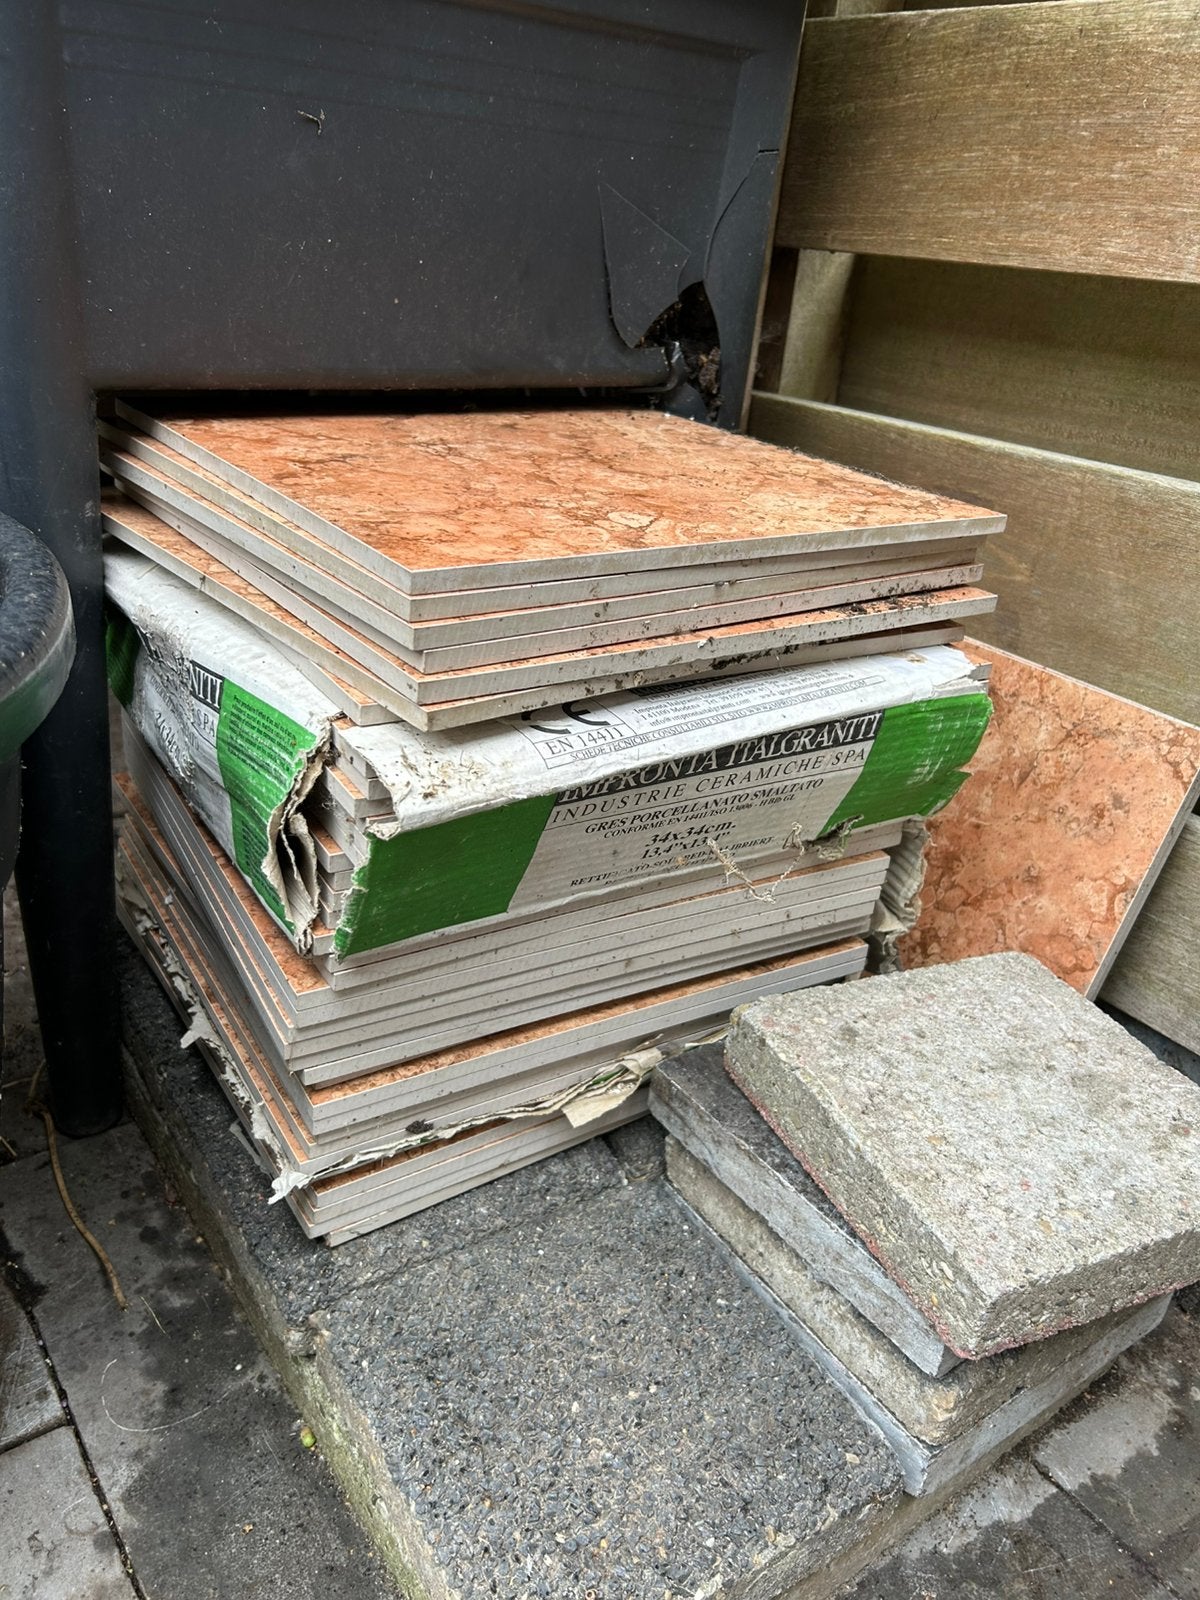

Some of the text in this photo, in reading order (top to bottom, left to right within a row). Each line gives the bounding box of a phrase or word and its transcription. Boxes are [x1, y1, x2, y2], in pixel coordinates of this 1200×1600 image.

[545, 727, 625, 755] EN 14411
[570, 746, 605, 761] SCHEDE
[606, 734, 650, 751] TECNICHE
[725, 713, 882, 767] ITALGRANITI
[552, 747, 865, 824] INDUSTRIE CERAMICHE SPA
[585, 778, 824, 834] GRES PORCELLANATO SMALTATO
[604, 820, 666, 838] CONFORME
[645, 821, 736, 848] 34x34cm.
